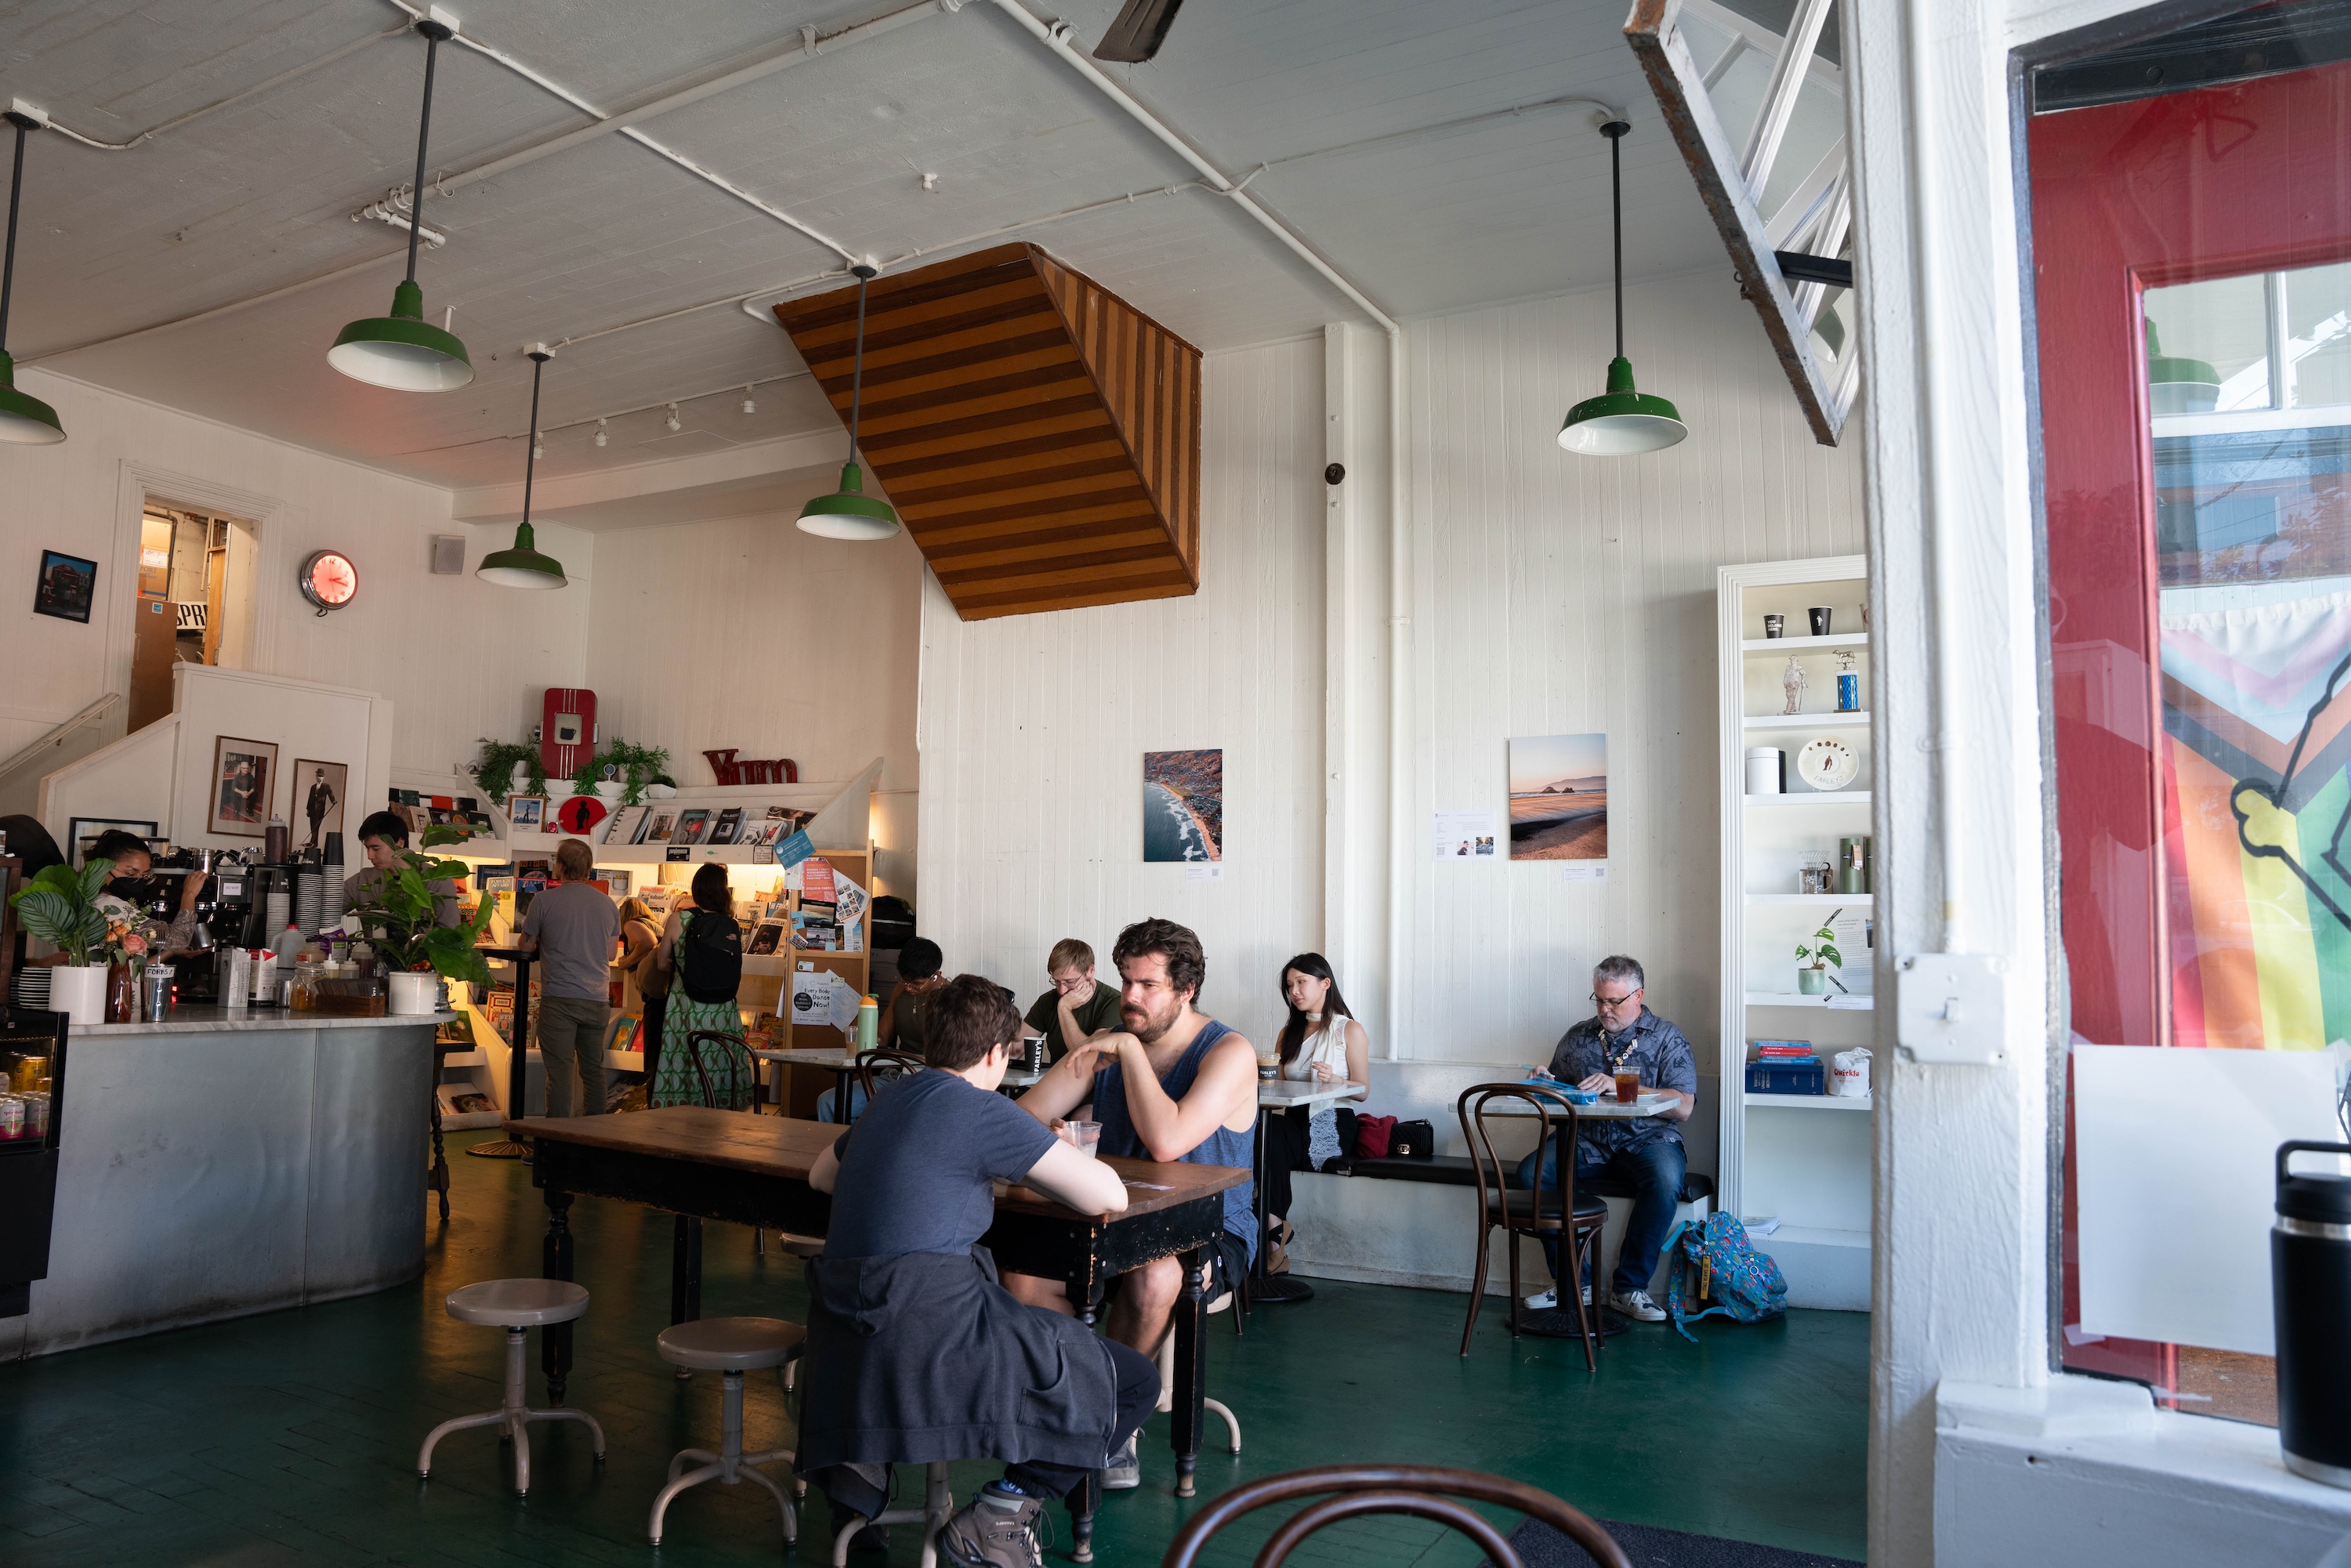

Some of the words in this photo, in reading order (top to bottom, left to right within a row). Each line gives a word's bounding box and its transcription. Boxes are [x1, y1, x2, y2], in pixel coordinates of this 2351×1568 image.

[1813, 775, 1843, 784] FARLEY'S
[1034, 1040, 1042, 1072] FARLEY'S
[1834, 1068, 1860, 1077] Qwirkle
